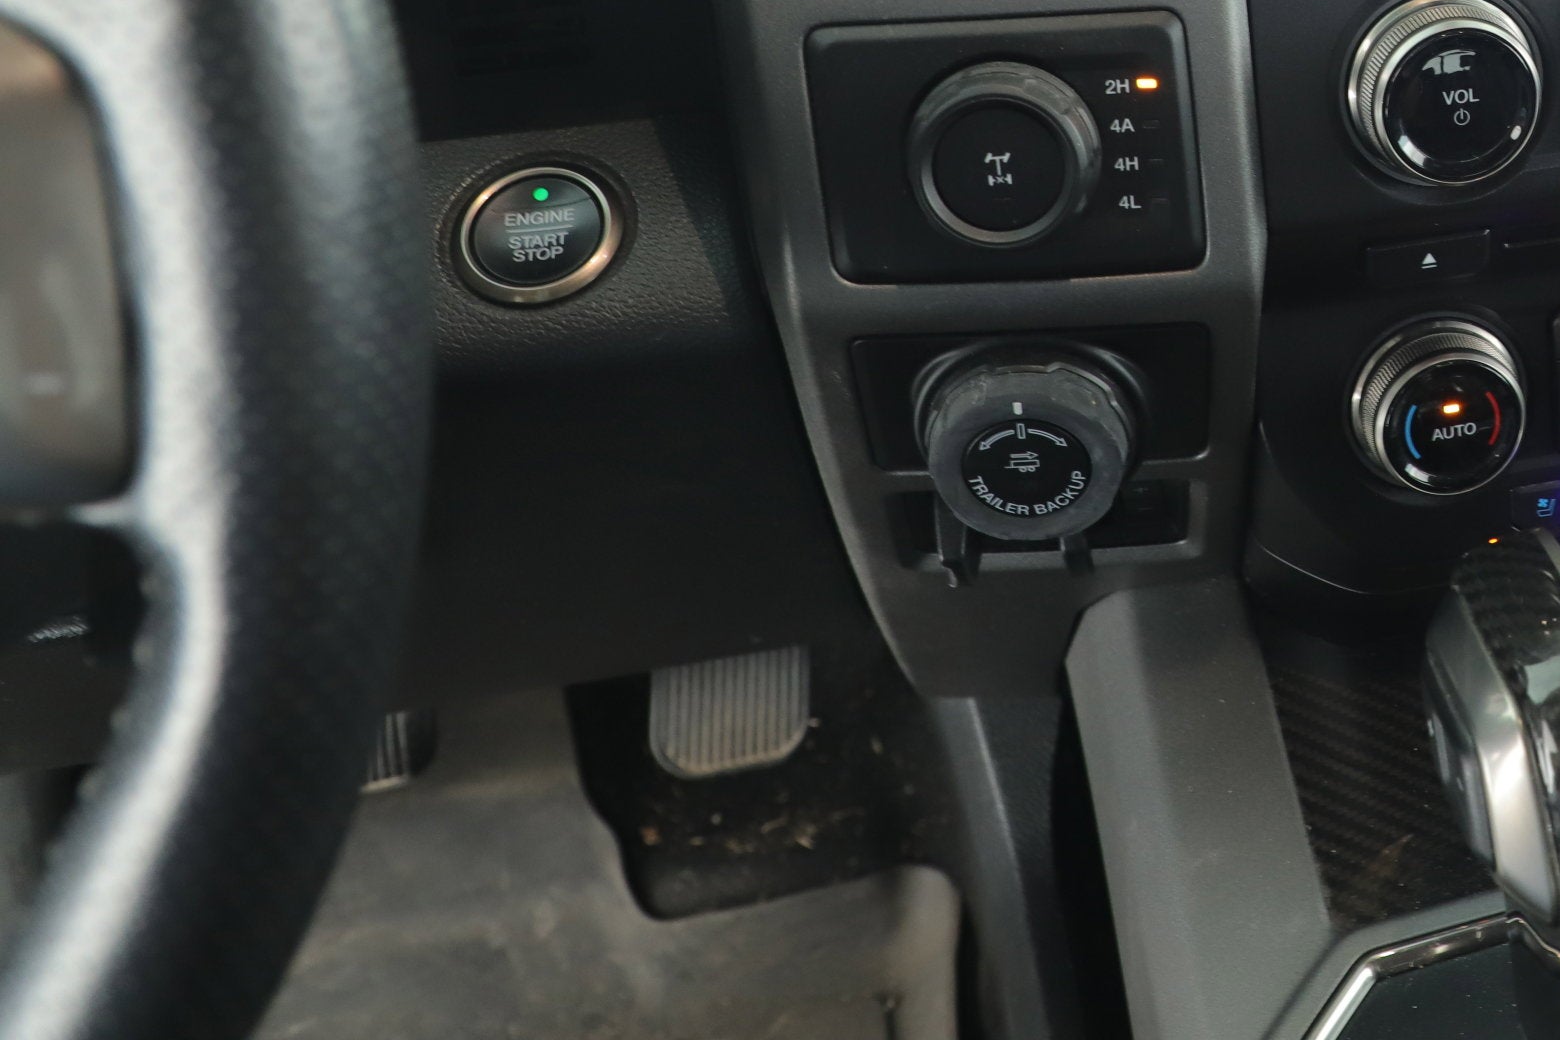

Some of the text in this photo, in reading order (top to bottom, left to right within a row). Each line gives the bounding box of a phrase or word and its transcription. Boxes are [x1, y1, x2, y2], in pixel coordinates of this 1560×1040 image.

[1104, 79, 1130, 95] 2H
[1442, 88, 1480, 105] VOL
[1110, 118, 1135, 133] 4A
[1114, 156, 1139, 171] 4H
[1119, 195, 1142, 209] 4L
[504, 208, 576, 227] ENGINE
[508, 232, 569, 250] START
[512, 246, 564, 262] STOP
[1432, 422, 1477, 442] AUTO
[968, 470, 1087, 516] TRAILER BACKUP
